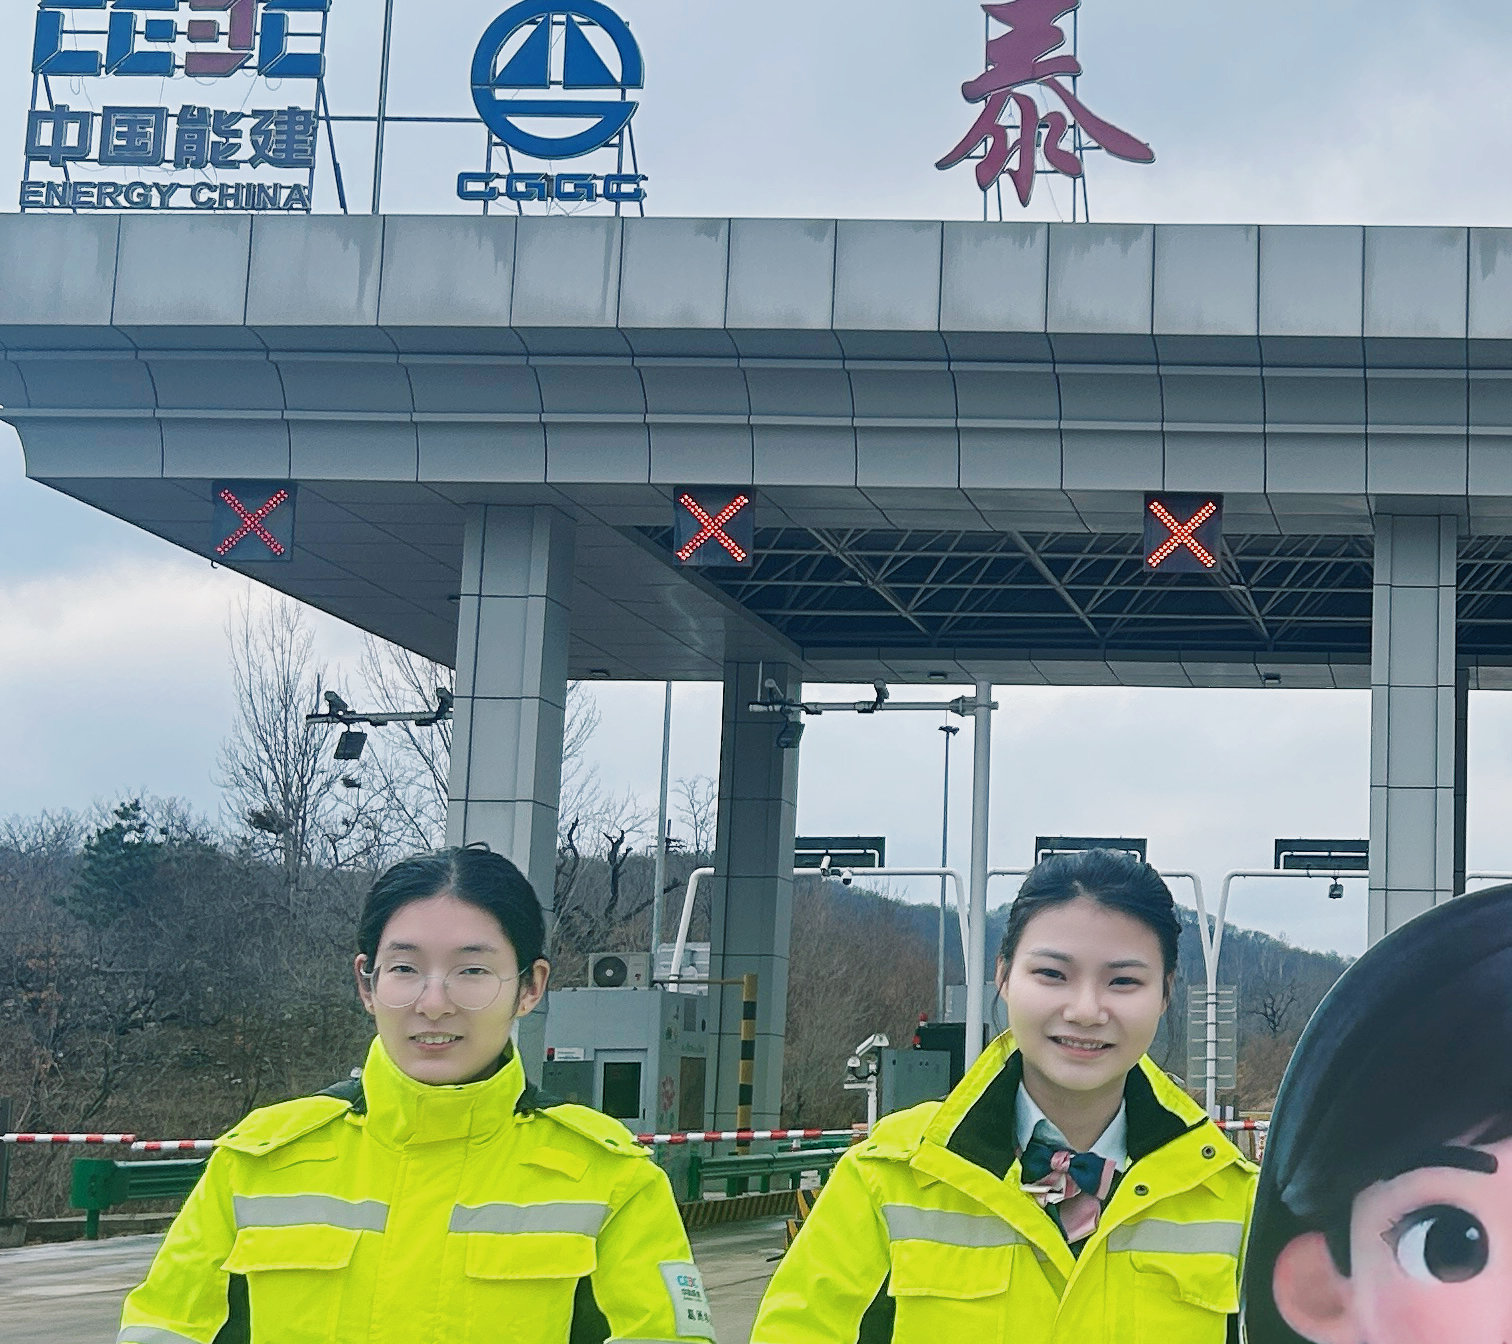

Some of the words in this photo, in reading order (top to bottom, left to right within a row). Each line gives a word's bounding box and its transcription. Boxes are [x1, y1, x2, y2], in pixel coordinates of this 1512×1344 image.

[24, 104, 316, 169] 中国能建
[20, 180, 180, 208] ENERGY
[190, 181, 311, 209] CHINA
[457, 172, 648, 202] CGGC
